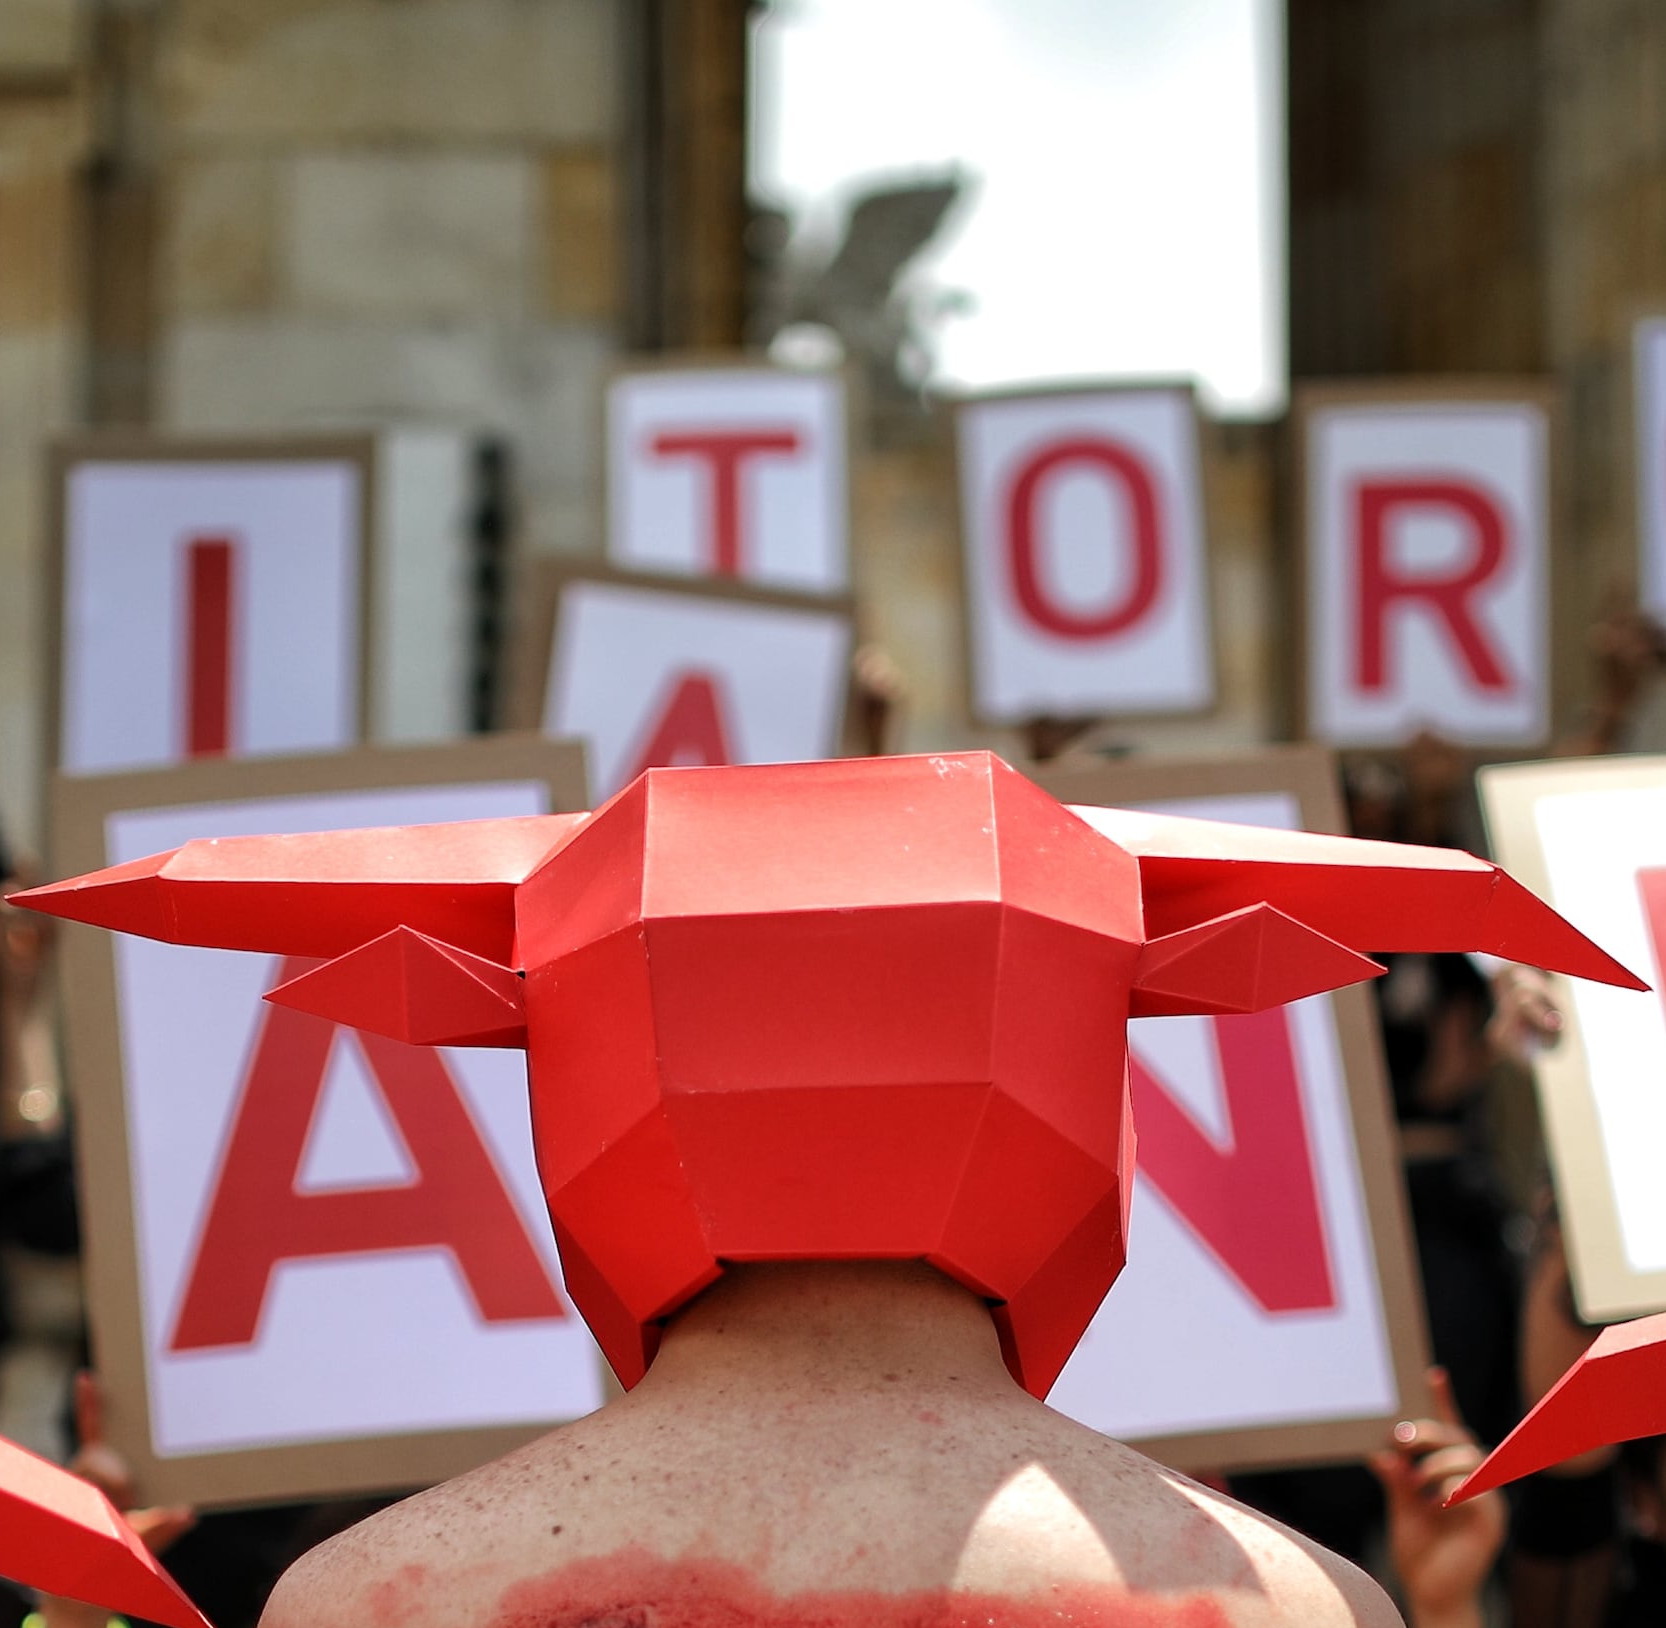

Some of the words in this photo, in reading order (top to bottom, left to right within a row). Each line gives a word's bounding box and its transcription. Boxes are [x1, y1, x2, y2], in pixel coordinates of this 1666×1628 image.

[644, 430, 807, 574] T
[1001, 429, 1171, 646] O
[1348, 472, 1519, 701] R
[165, 955, 573, 1356] A
